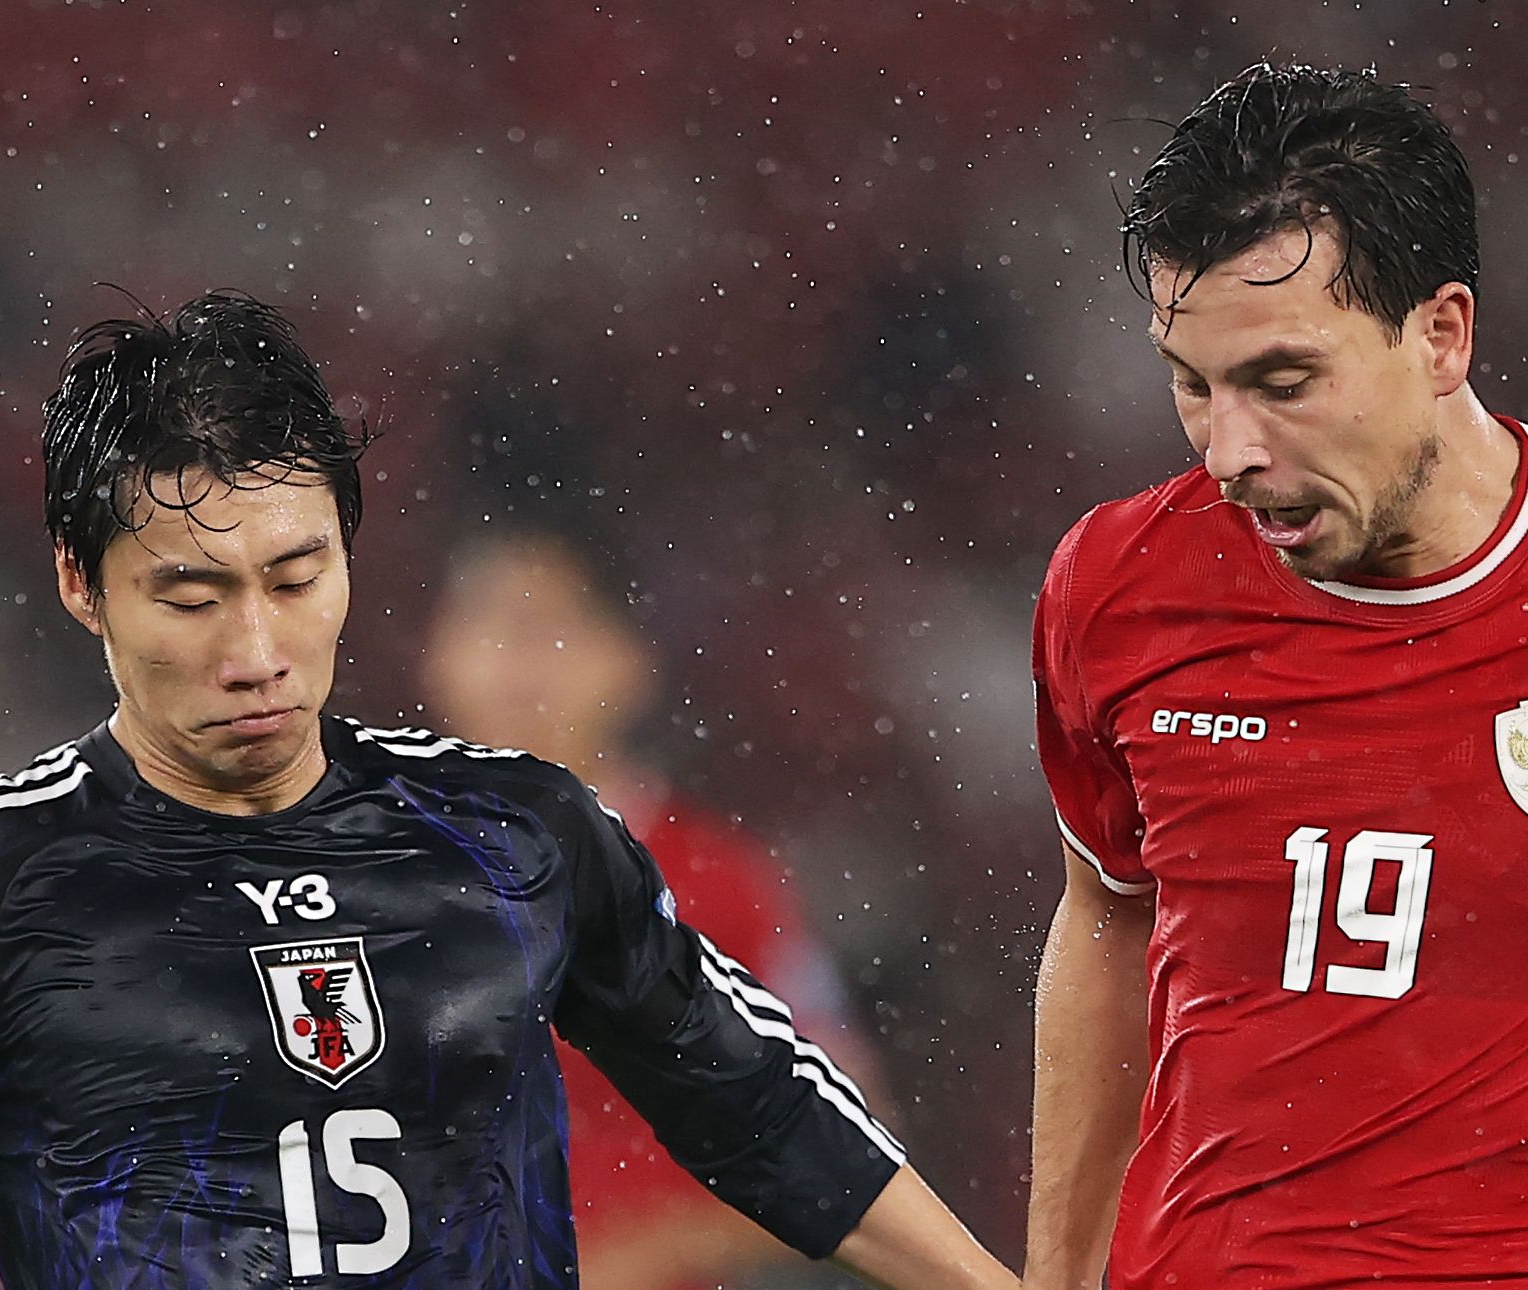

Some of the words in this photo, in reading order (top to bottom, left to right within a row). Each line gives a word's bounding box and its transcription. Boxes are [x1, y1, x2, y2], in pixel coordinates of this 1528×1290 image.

[1151, 708, 1267, 745] erspo
[233, 873, 337, 925] Y-3
[1281, 825, 1435, 1000] 19
[279, 946, 338, 963] JAPAN
[308, 1034, 356, 1061] JFA
[277, 1108, 412, 1278] 15
